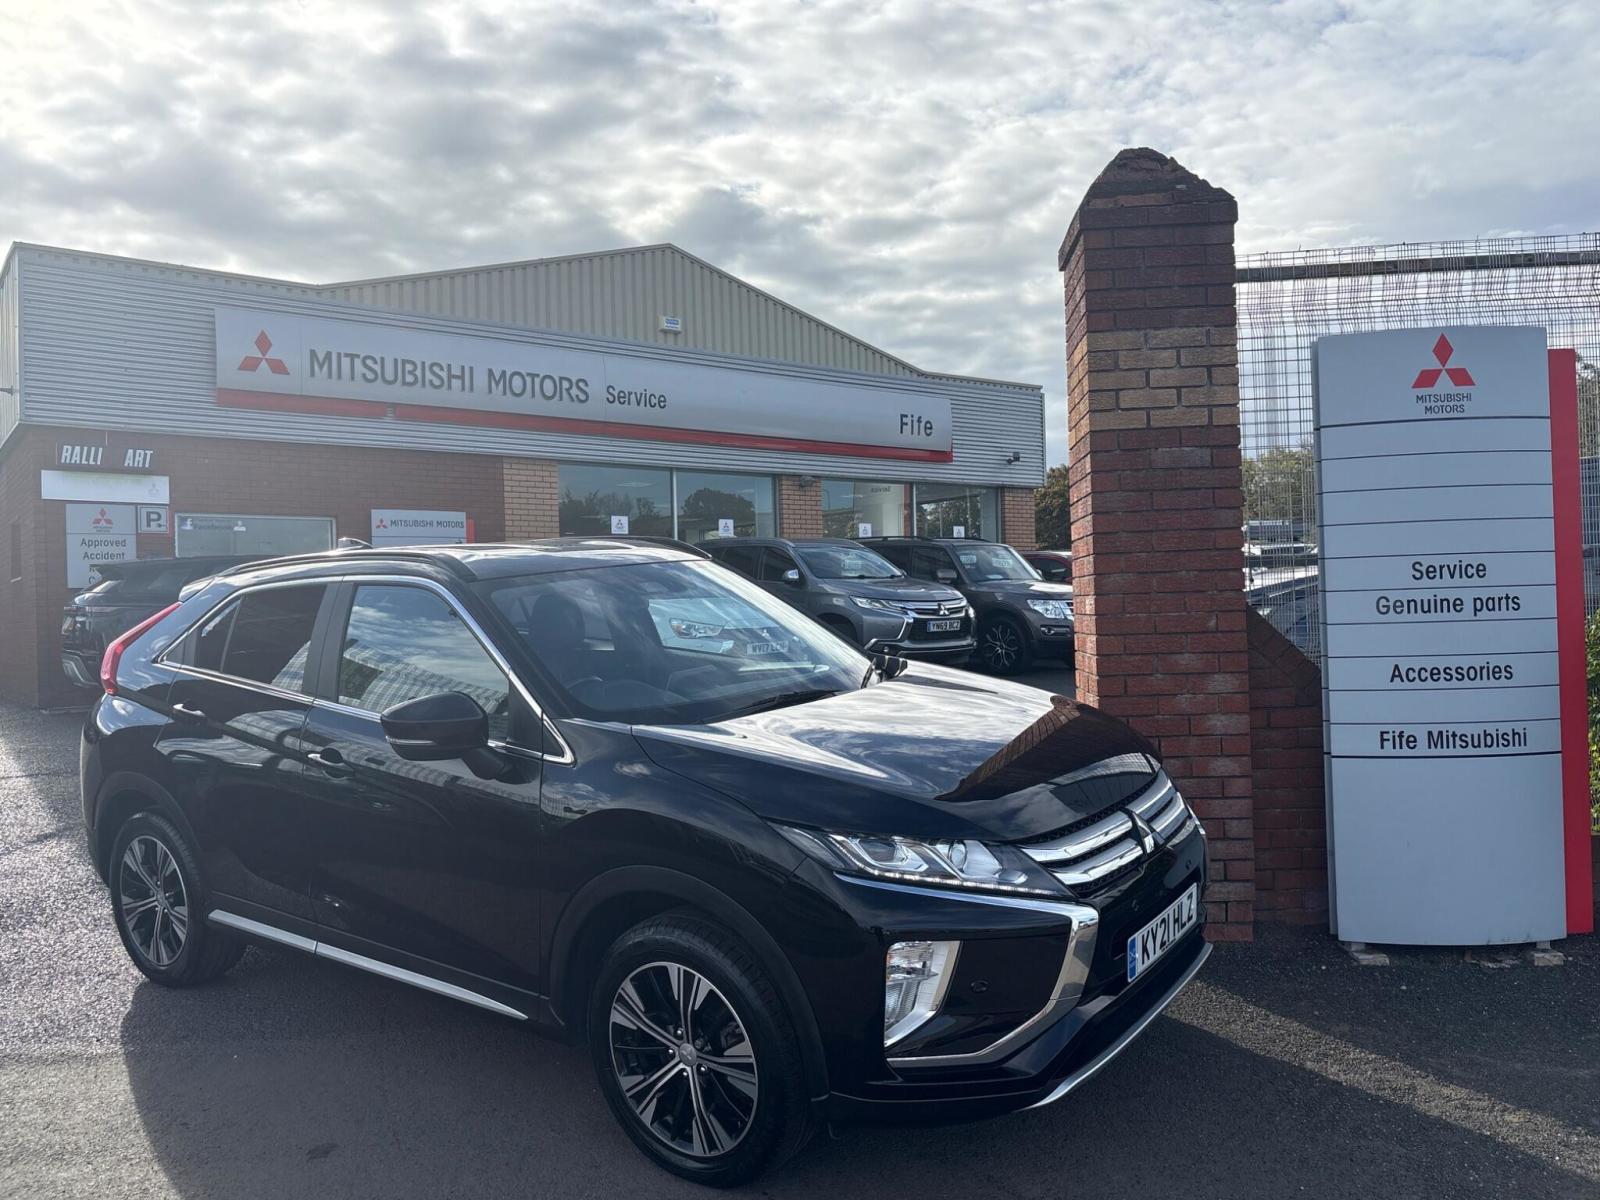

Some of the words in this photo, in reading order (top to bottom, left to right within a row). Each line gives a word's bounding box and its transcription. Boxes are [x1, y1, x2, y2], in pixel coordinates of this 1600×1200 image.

[309, 348, 475, 393] MITSUBISHI
[487, 367, 590, 404] MOTORS
[606, 384, 667, 410] Service
[1415, 392, 1472, 404] MITSUBISHI
[1424, 404, 1465, 415] MOTORS
[899, 412, 934, 438] Fife
[61, 445, 103, 465] RALLI
[124, 449, 154, 468] ART
[146, 510, 162, 528] P
[390, 519, 434, 528] MITSUBISHI
[436, 520, 465, 529] MOTORS
[80, 537, 127, 549] Approved
[82, 551, 125, 561] Accident
[1411, 559, 1487, 581] Service
[1375, 594, 1464, 615] Genuine
[1473, 592, 1521, 617] parts
[1389, 661, 1514, 683] Accessories
[1379, 730, 1418, 750] Fife
[1427, 727, 1528, 749] Mitsubishi
